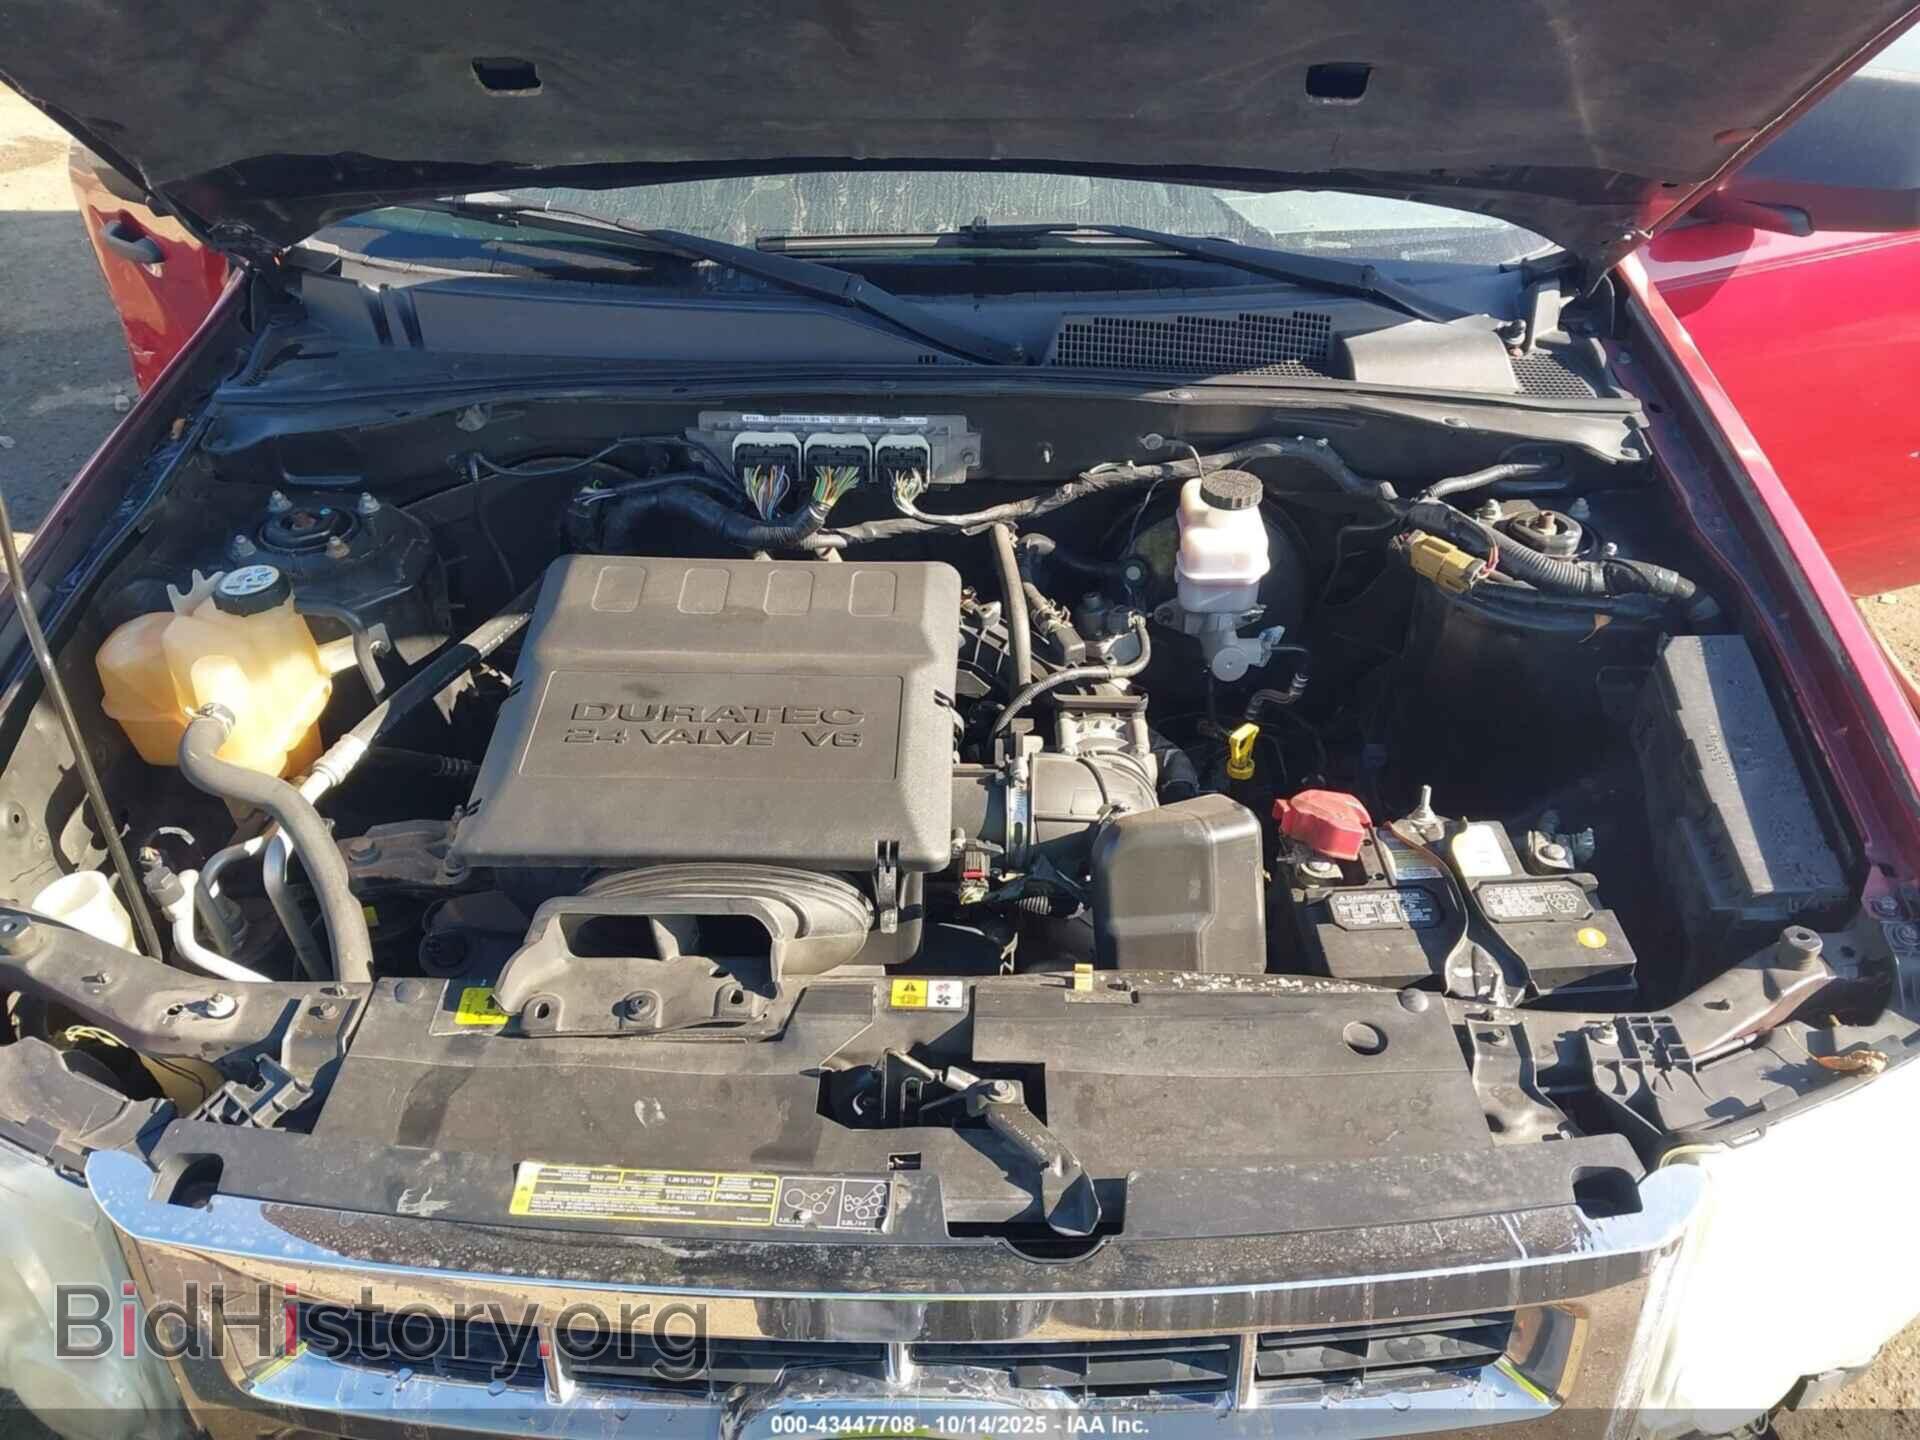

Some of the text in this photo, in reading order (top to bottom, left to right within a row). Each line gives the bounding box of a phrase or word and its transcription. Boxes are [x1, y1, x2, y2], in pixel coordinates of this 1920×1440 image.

[570, 702, 866, 725] DURATEC
[563, 727, 864, 747] 24 VALVE V6
